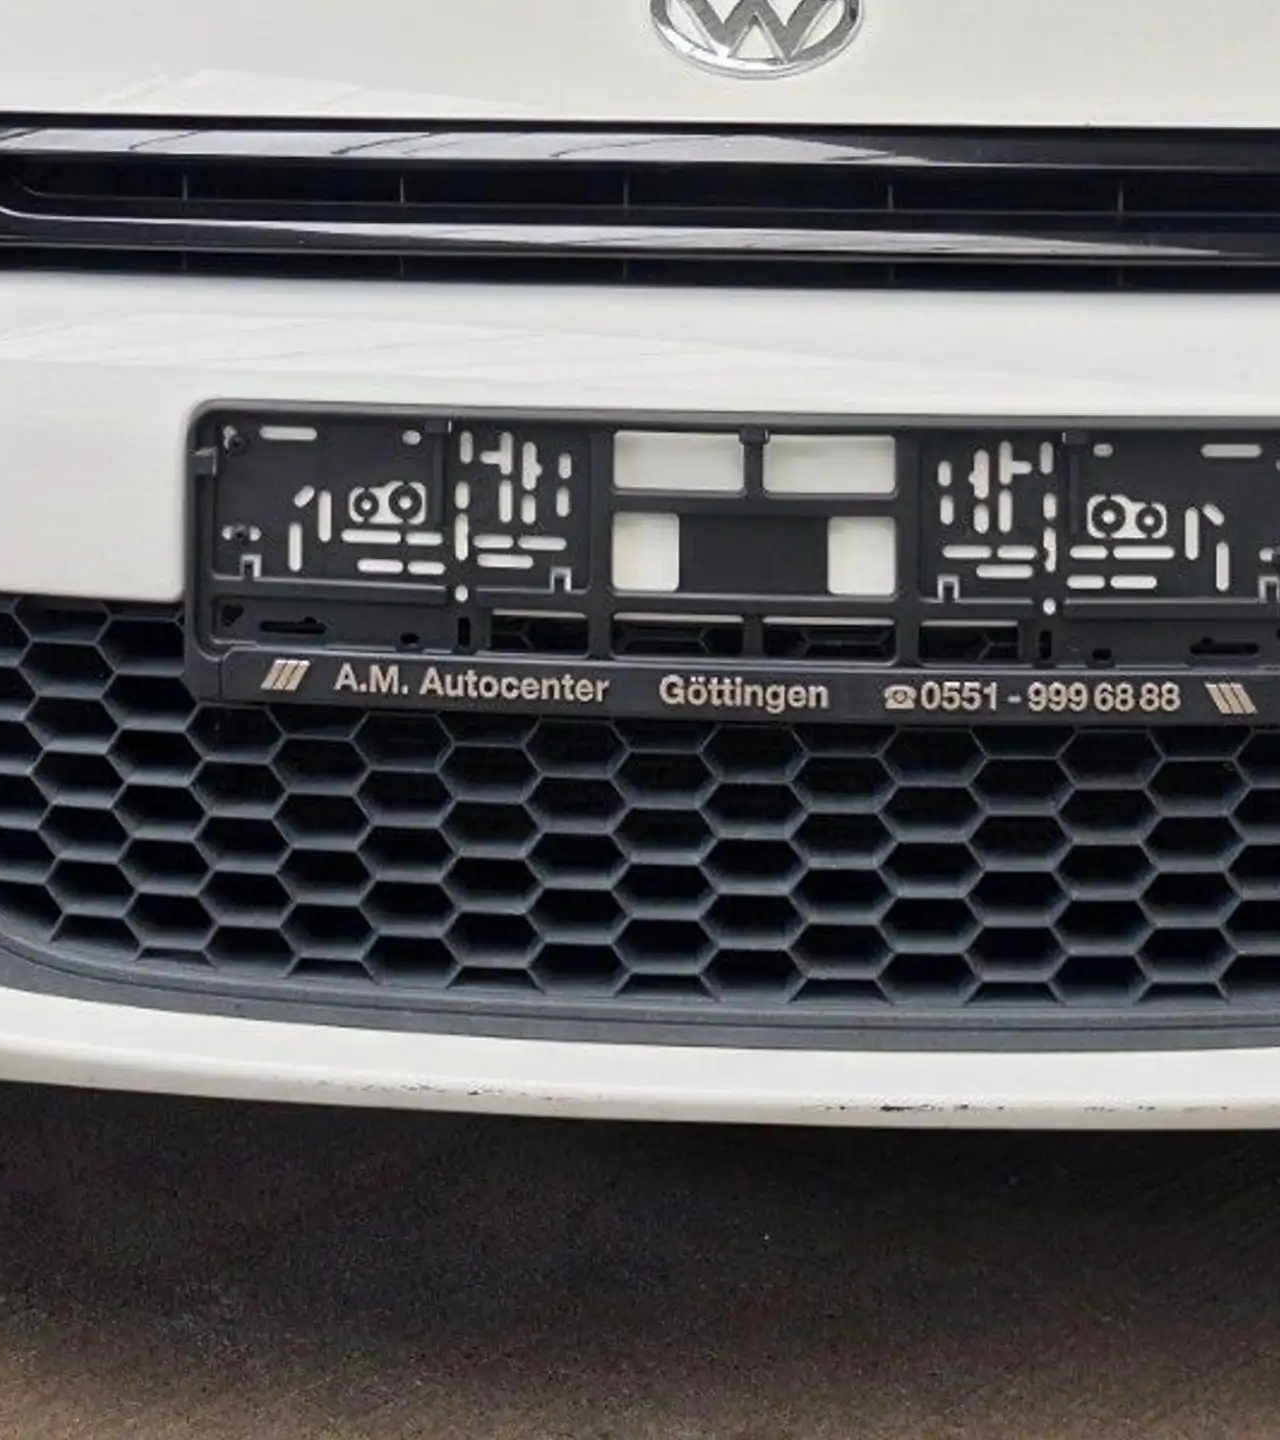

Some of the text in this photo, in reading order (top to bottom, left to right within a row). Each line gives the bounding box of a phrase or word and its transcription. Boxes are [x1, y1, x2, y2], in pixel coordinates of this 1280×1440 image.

[334, 662, 409, 695] A.M.
[419, 666, 611, 703] Autocenter
[658, 674, 830, 714] Göttingen
[921, 681, 998, 711] 0551
